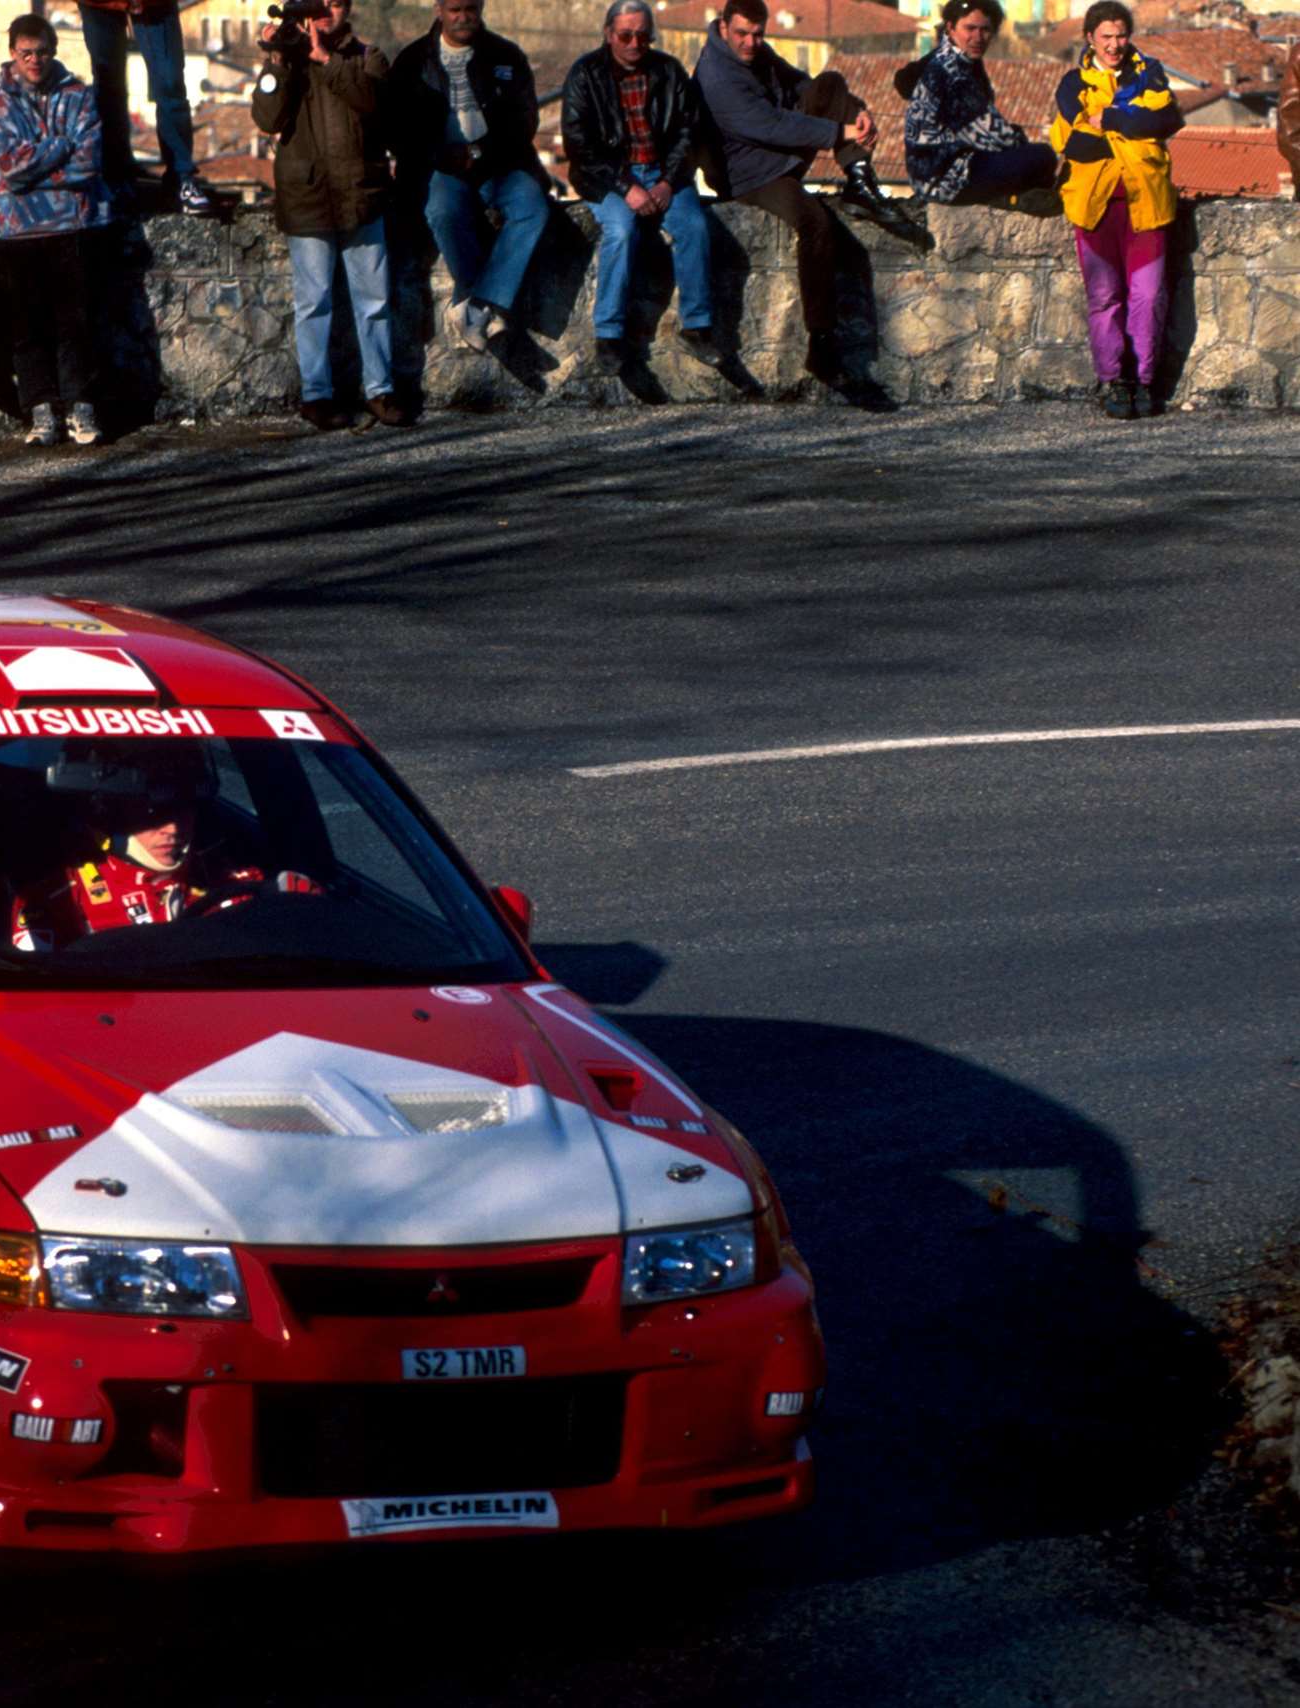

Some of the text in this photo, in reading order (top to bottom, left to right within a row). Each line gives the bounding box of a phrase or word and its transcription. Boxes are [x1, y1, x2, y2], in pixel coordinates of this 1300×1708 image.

[414, 1348, 516, 1378] S2 TMR
[13, 1413, 103, 1444] RALLI ART
[383, 1497, 548, 1520] MICHELIN
